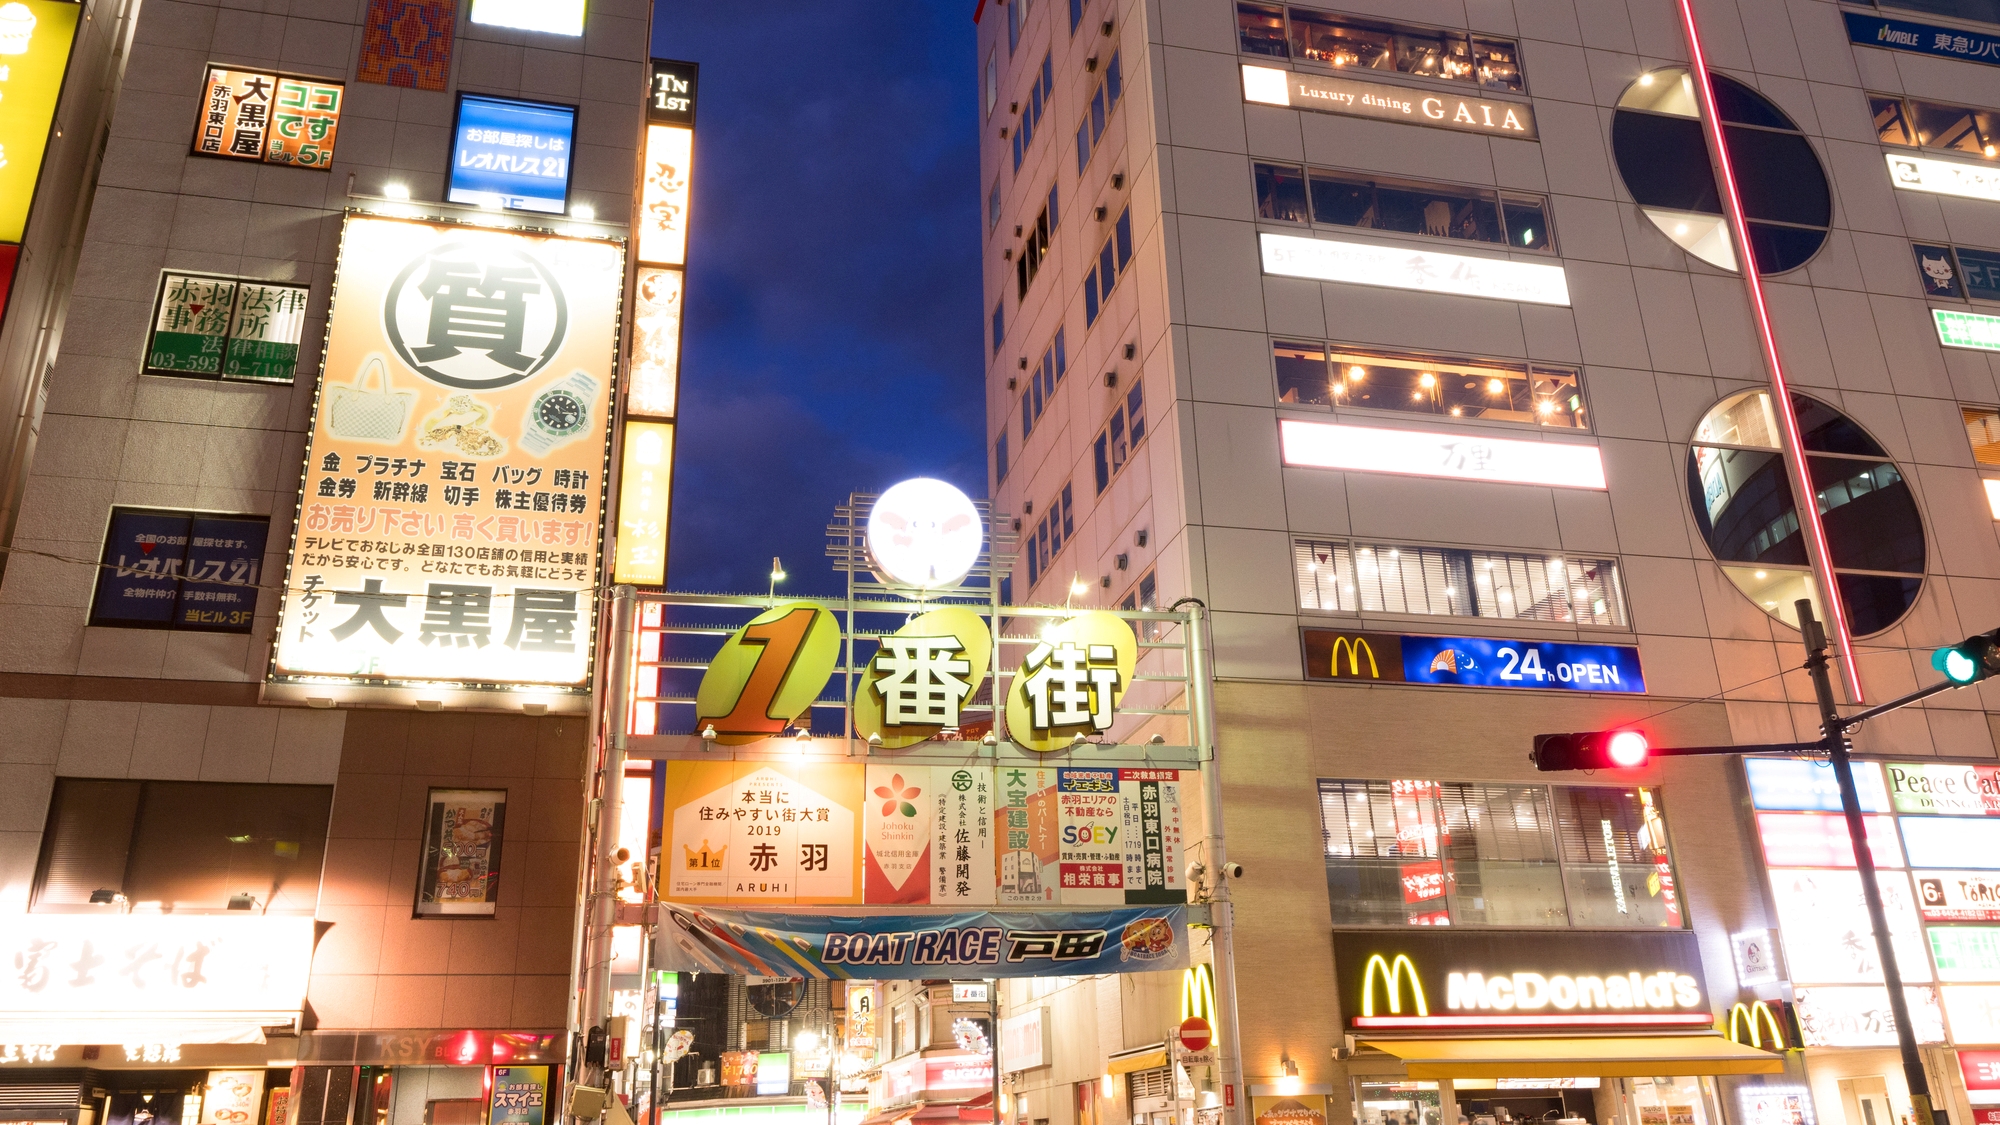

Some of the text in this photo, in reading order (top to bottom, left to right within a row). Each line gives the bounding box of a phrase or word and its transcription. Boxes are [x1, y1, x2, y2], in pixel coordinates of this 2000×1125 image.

[278, 82, 340, 112] ココ
[1299, 84, 1524, 131] Luxury dining GAIA
[202, 85, 231, 152] 赤羽東口店
[229, 77, 272, 156] 大黒屋
[275, 113, 336, 140] です
[466, 128, 565, 151] お部屋探しは
[167, 278, 307, 314] 赤羽法律
[162, 304, 269, 338] 事務所
[416, 253, 544, 376] 質
[202, 336, 297, 360] 法律相談
[151, 352, 294, 378] 03-5939-7194
[321, 452, 589, 490] 金 プラチナ 宝石 バッグ 時計
[317, 477, 587, 514] 金券 新幹線 切手 株主優待券
[305, 503, 446, 538] お売り下さい
[304, 536, 589, 567] テレビでおなじみ全国130店舗の信用と実績
[421, 558, 588, 582] どなたでもお気軽にどうぞ
[298, 574, 324, 643] チケット
[329, 578, 578, 653] 大黒屋
[1556, 662, 1620, 685] OPEN
[1124, 771, 1173, 780] 二次救急指定
[1889, 767, 1957, 795] Peace
[741, 790, 789, 805] 本当に
[1006, 769, 1030, 849] 大宝建設
[1036, 770, 1047, 850] 住まいのパートナー
[1061, 795, 1117, 805] 赤羽エリアの
[699, 806, 830, 822] 住みやすい街大賞
[1065, 807, 1114, 817] 不動産なら
[1172, 807, 1180, 843] 年中無休
[747, 825, 781, 836] 2019
[881, 822, 914, 830] Johoku
[881, 832, 914, 840] Shinkin
[1062, 825, 1118, 845] SOEY
[1142, 785, 1163, 886] 赤羽東口病院
[749, 842, 829, 872] 赤羽
[876, 850, 919, 858] 城北信用金庫
[954, 794, 971, 897] 株式会社 佐藤開発
[688, 851, 721, 868] 第1位
[736, 883, 788, 893] ARUHI
[1064, 873, 1120, 886] 相栄商事
[821, 927, 1107, 965] BOAT RACE 戸田
[1447, 970, 1700, 1010] McDonald's
[380, 1036, 433, 1058] KSY
[1182, 1055, 1213, 1064] 自転車を除く
[494, 1092, 543, 1108] スマイエ
